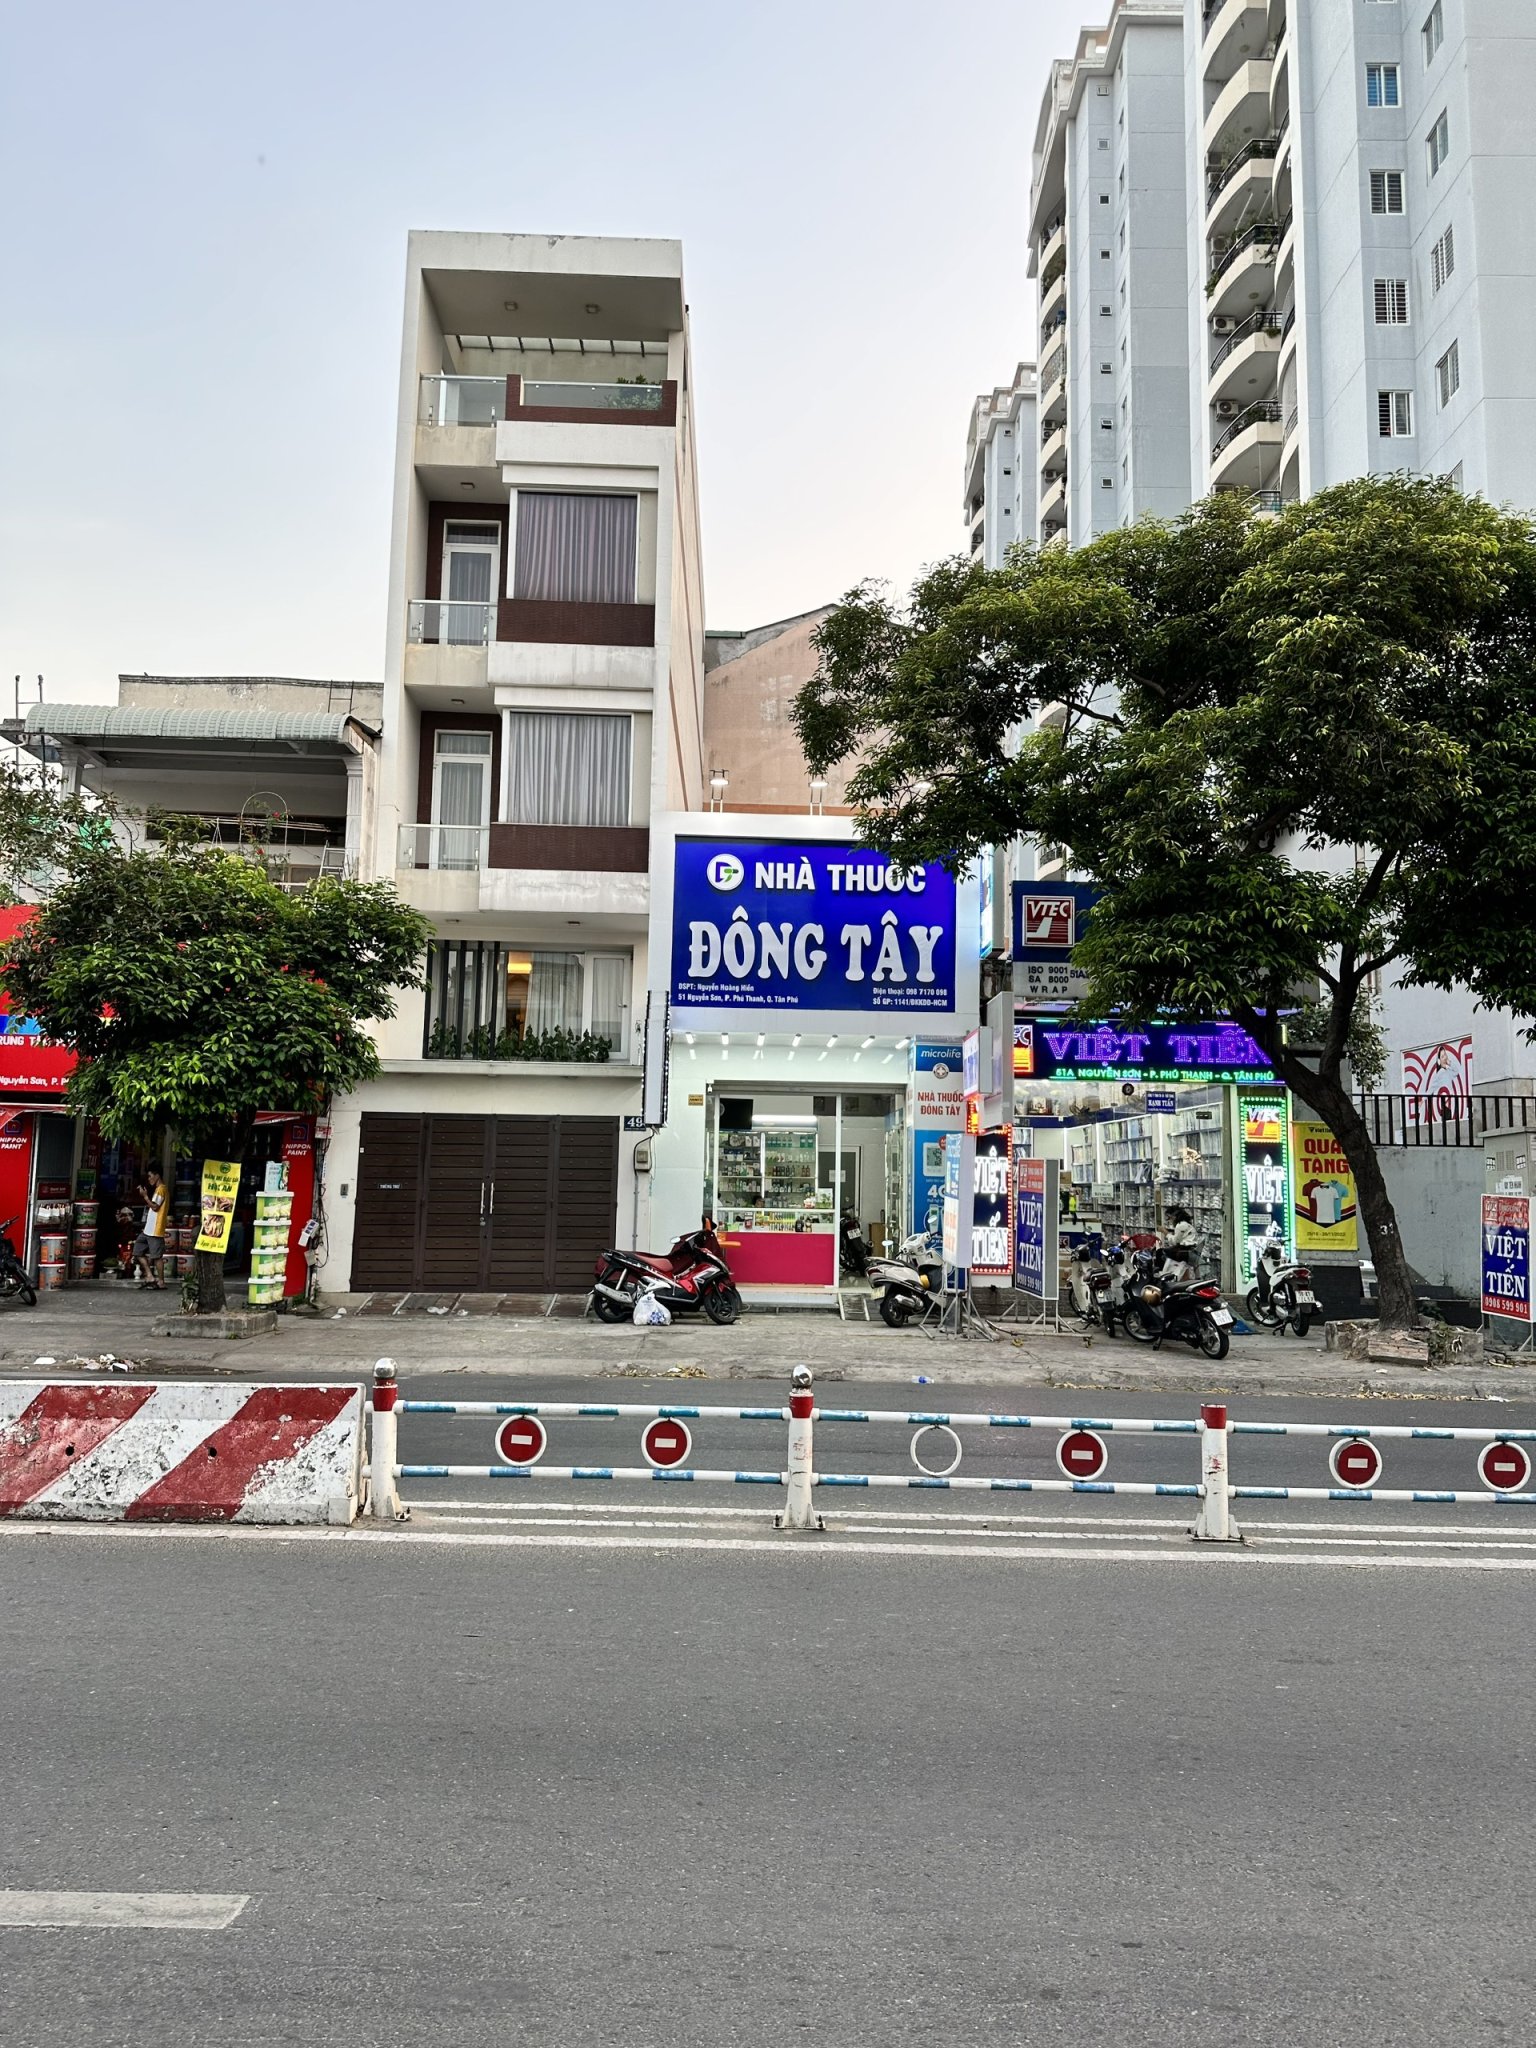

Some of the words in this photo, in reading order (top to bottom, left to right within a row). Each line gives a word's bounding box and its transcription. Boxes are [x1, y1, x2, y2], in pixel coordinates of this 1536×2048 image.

[755, 857, 816, 890] NHÀ
[1028, 901, 1070, 919] VTEC
[688, 905, 827, 980] ĐÔNG
[840, 909, 944, 983] TÂY
[1028, 966, 1044, 974] ISO
[1048, 966, 1068, 974] 9001
[697, 983, 719, 992] Nguyễn
[687, 993, 710, 1002] Nguyễn
[787, 995, 799, 1003] Phú
[921, 1048, 961, 1058] microlife
[1043, 1026, 1150, 1067] VIỆT
[1056, 1069, 1074, 1077] 51A
[1078, 1067, 1120, 1079] NGUYỄN
[1150, 1070, 1158, 1078] P.
[1160, 1069, 1179, 1079] PHÚ
[1234, 1071, 1255, 1080] TÂN
[1255, 1071, 1274, 1081] PHÚ
[918, 1090, 935, 1101] NHÀ
[945, 1105, 961, 1115] TÂY
[1485, 1229, 1526, 1264] VIỆT
[1486, 1264, 1526, 1298] TIẾN
[1485, 1296, 1500, 1309] 0908
[1501, 1299, 1513, 1311] 599
[1515, 1302, 1527, 1313] 901
